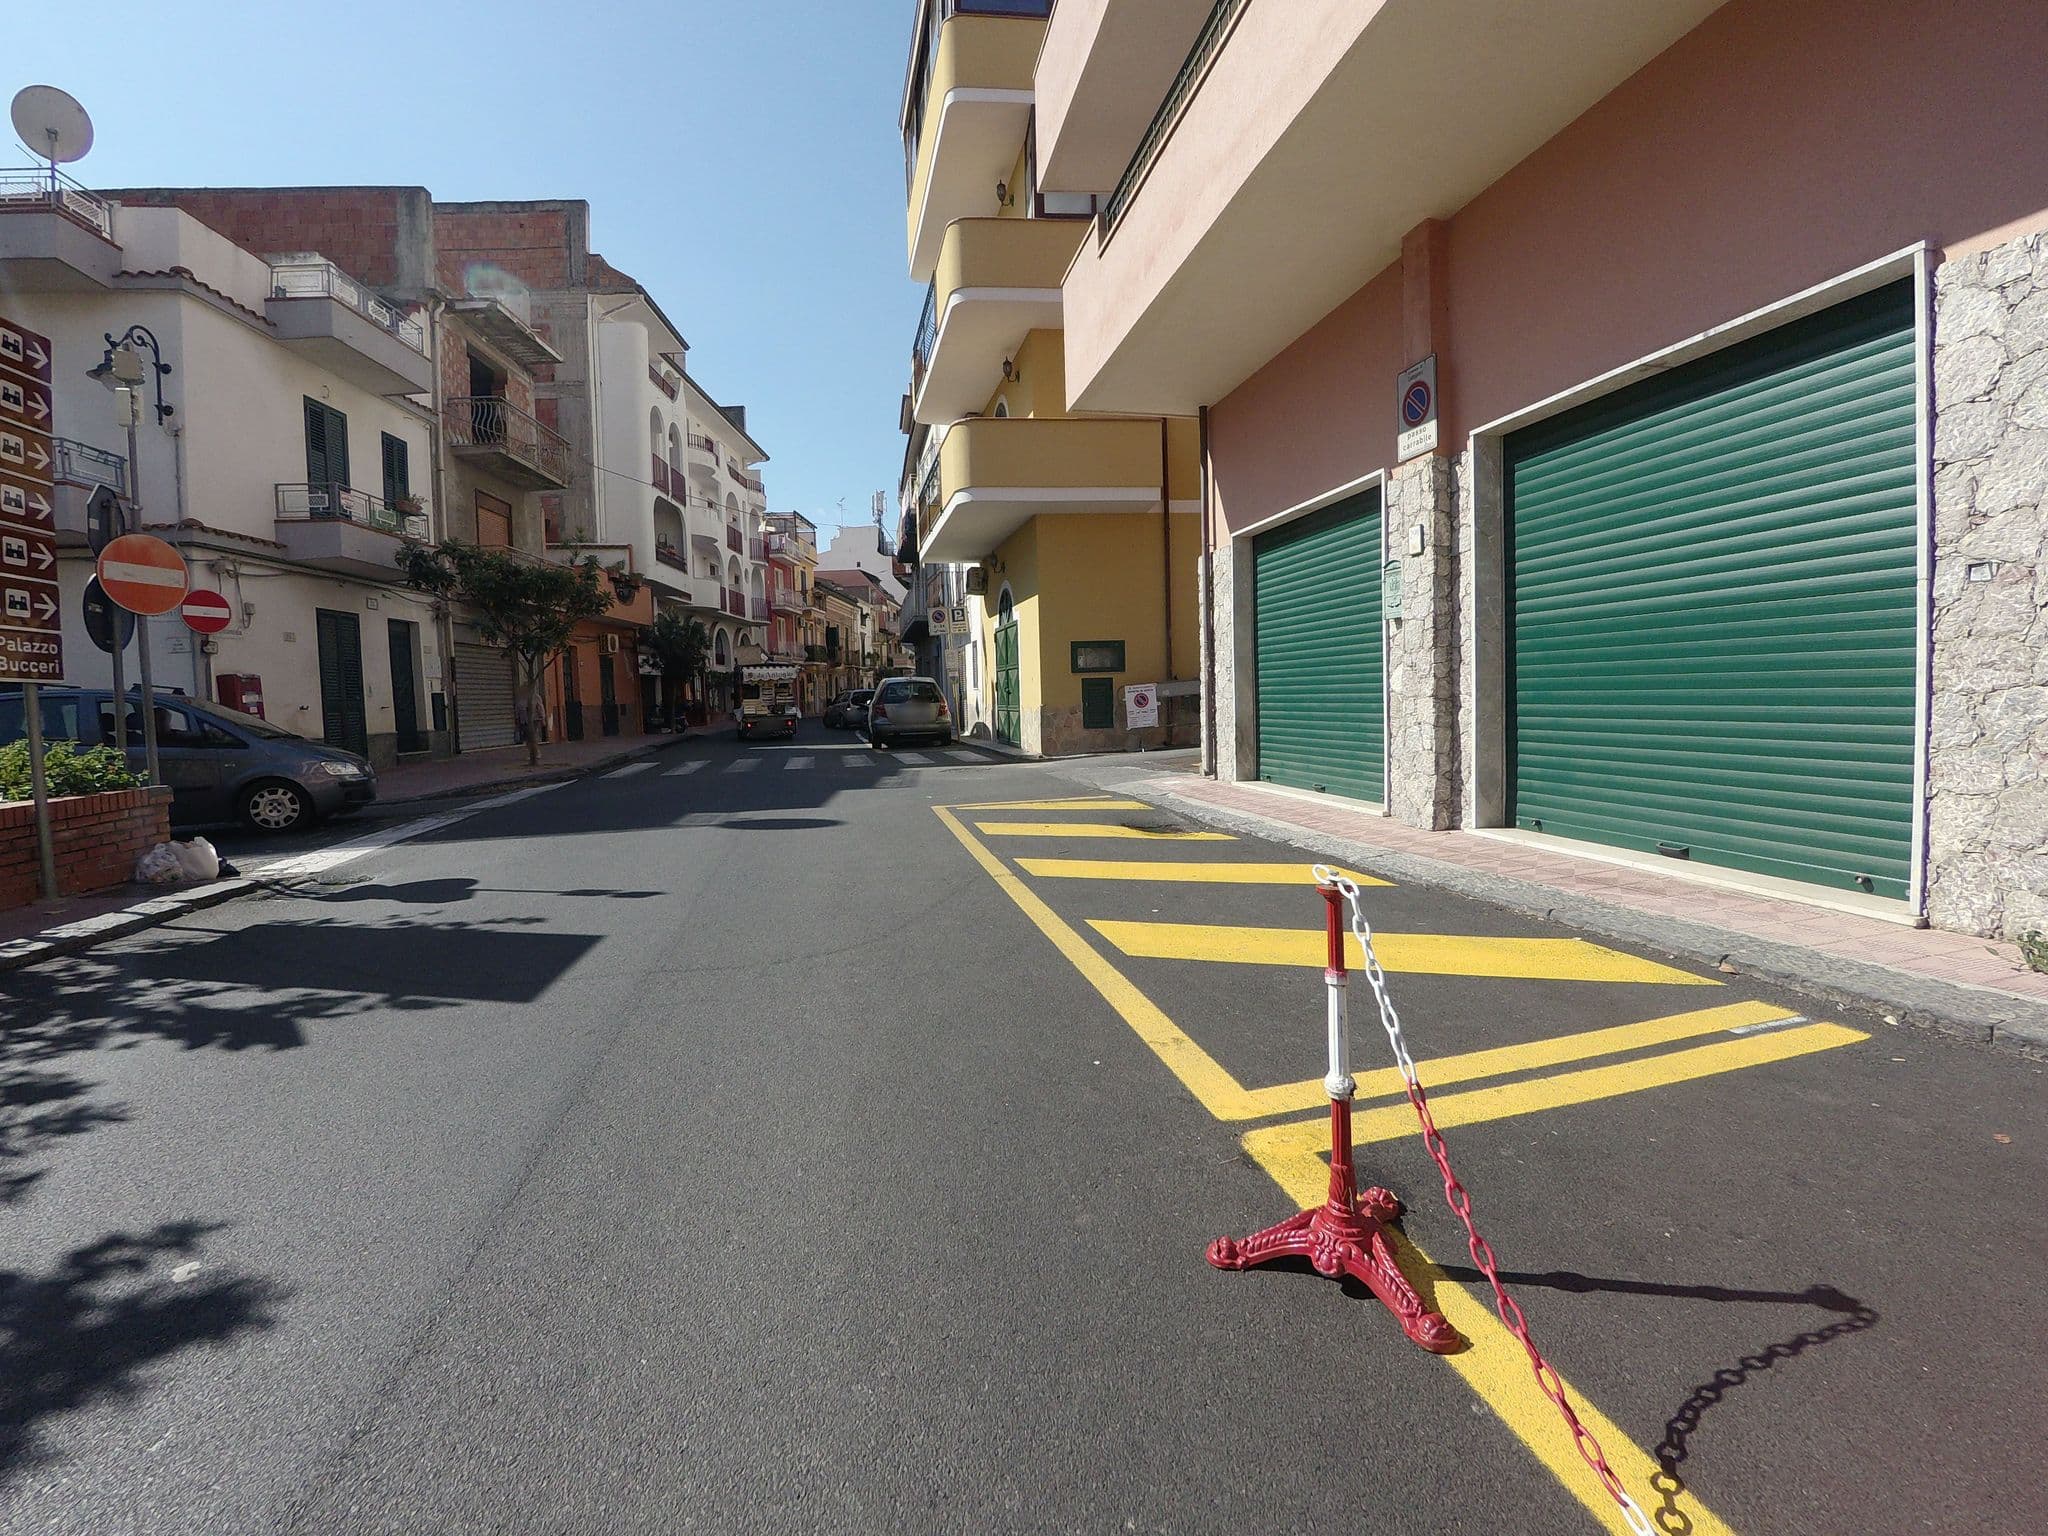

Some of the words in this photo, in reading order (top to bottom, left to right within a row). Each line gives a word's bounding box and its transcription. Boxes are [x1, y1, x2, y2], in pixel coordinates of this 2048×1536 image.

[1407, 426, 1427, 440] passo
[1403, 434, 1432, 451] carrabile
[0, 636, 58, 655] Palazzo
[0, 656, 59, 674] Bucceri
